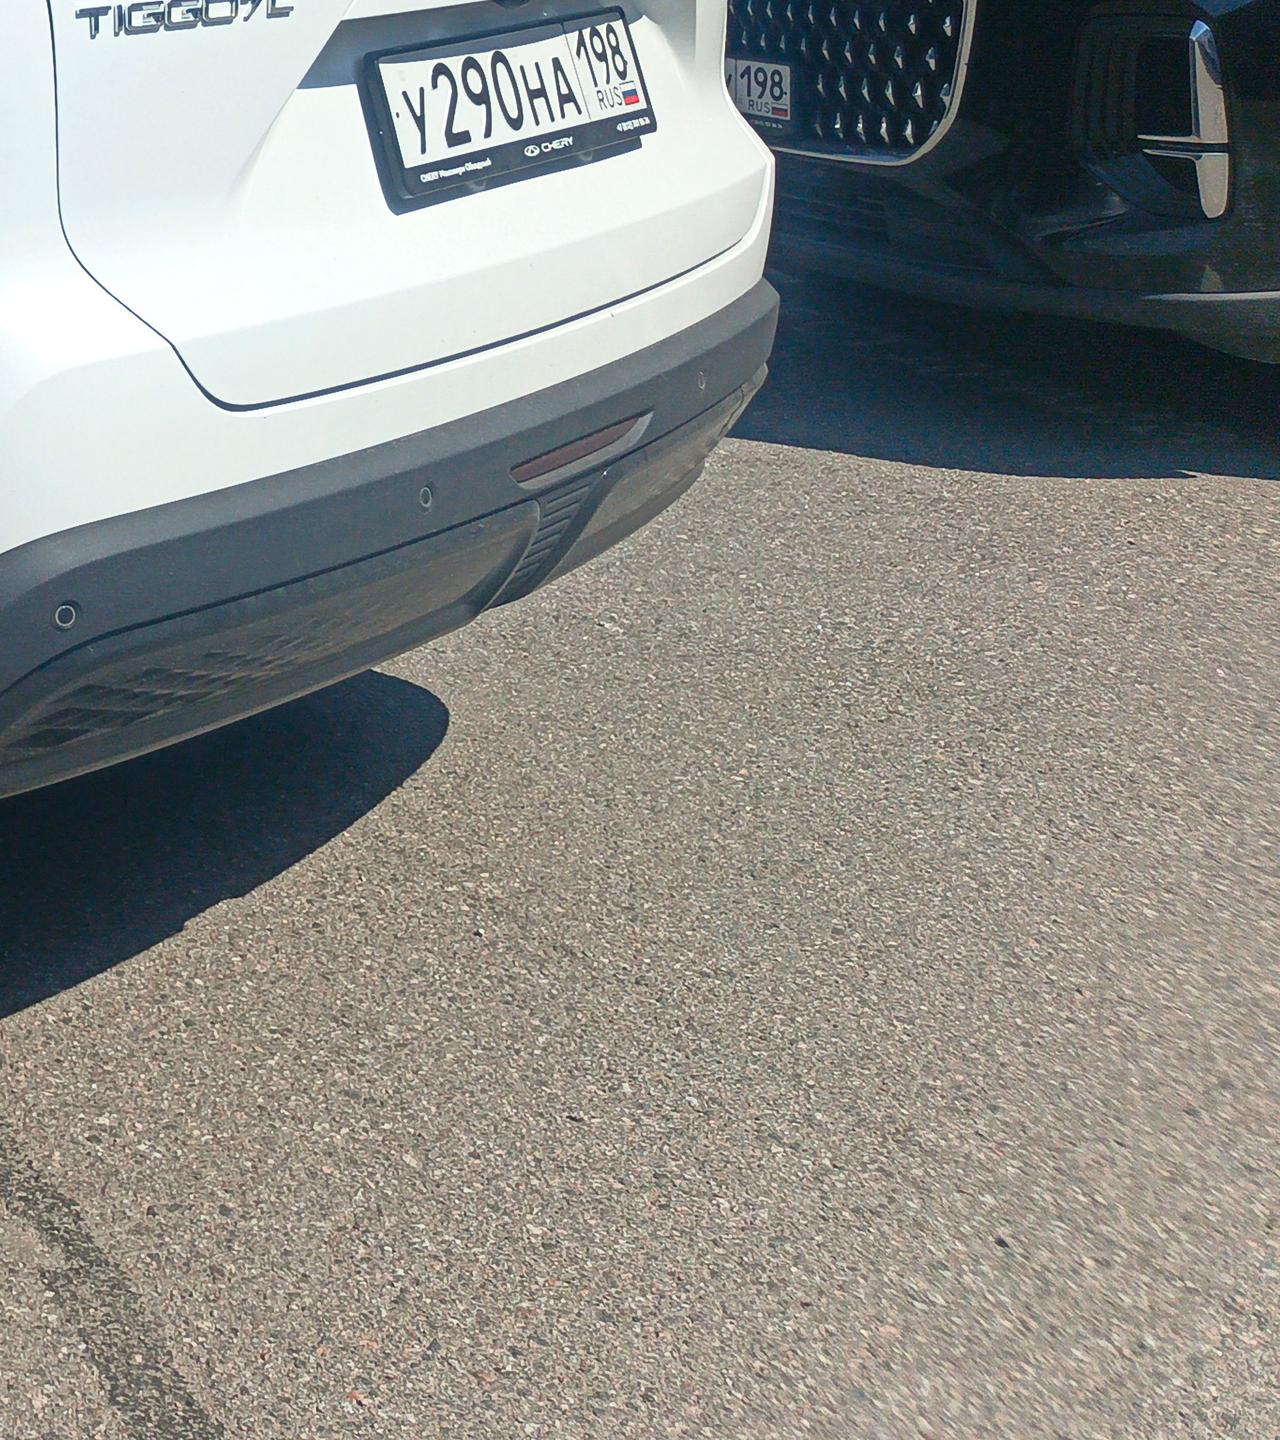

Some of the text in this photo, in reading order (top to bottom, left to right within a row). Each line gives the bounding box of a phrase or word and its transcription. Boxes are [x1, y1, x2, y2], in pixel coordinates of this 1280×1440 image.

[575, 23, 628, 88] 198
[740, 64, 784, 102] 198
[596, 85, 622, 110] RUS
[748, 99, 771, 114] RUS
[541, 135, 573, 153] CHERY
